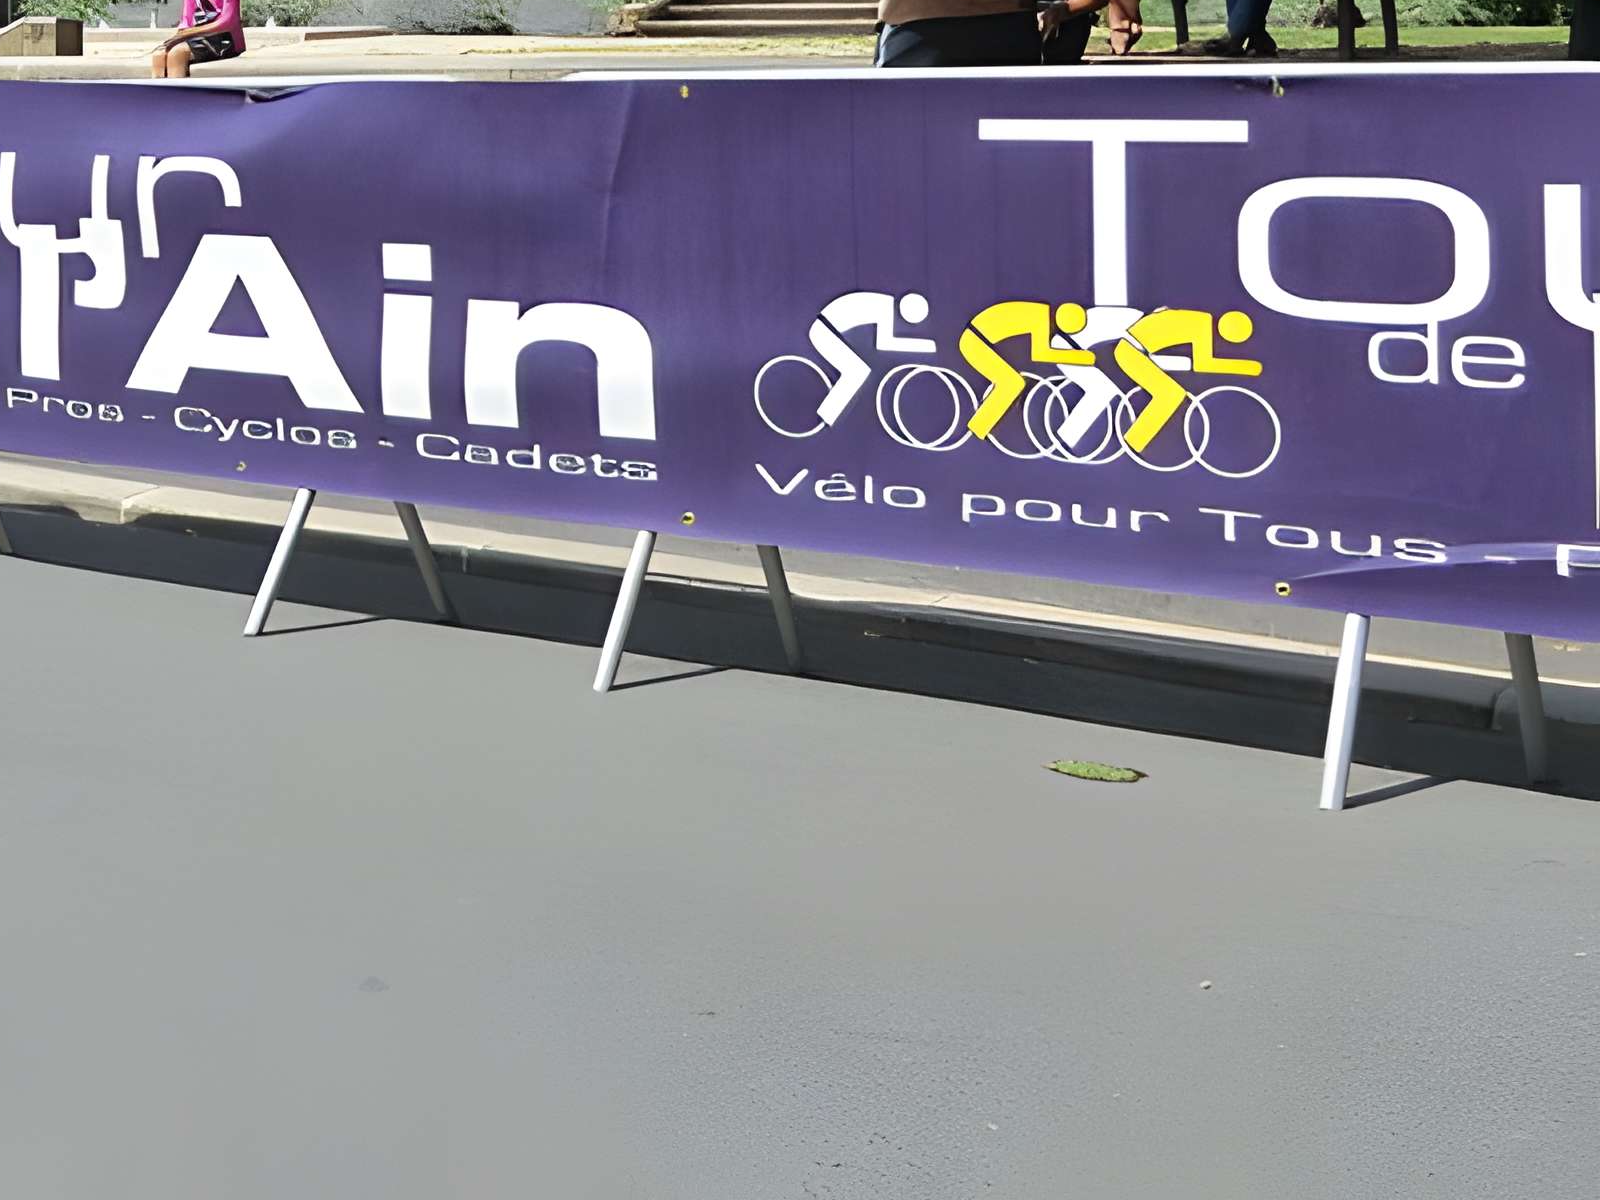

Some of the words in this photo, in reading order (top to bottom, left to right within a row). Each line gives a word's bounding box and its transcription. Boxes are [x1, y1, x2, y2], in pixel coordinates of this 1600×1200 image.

[16, 218, 657, 441] l'Ain
[1367, 321, 1526, 389] de
[174, 406, 356, 449] Cyclos
[416, 433, 658, 481] Cadets
[755, 463, 926, 508] Vélo
[962, 493, 1170, 532] pour
[1199, 506, 1448, 564] Tous
